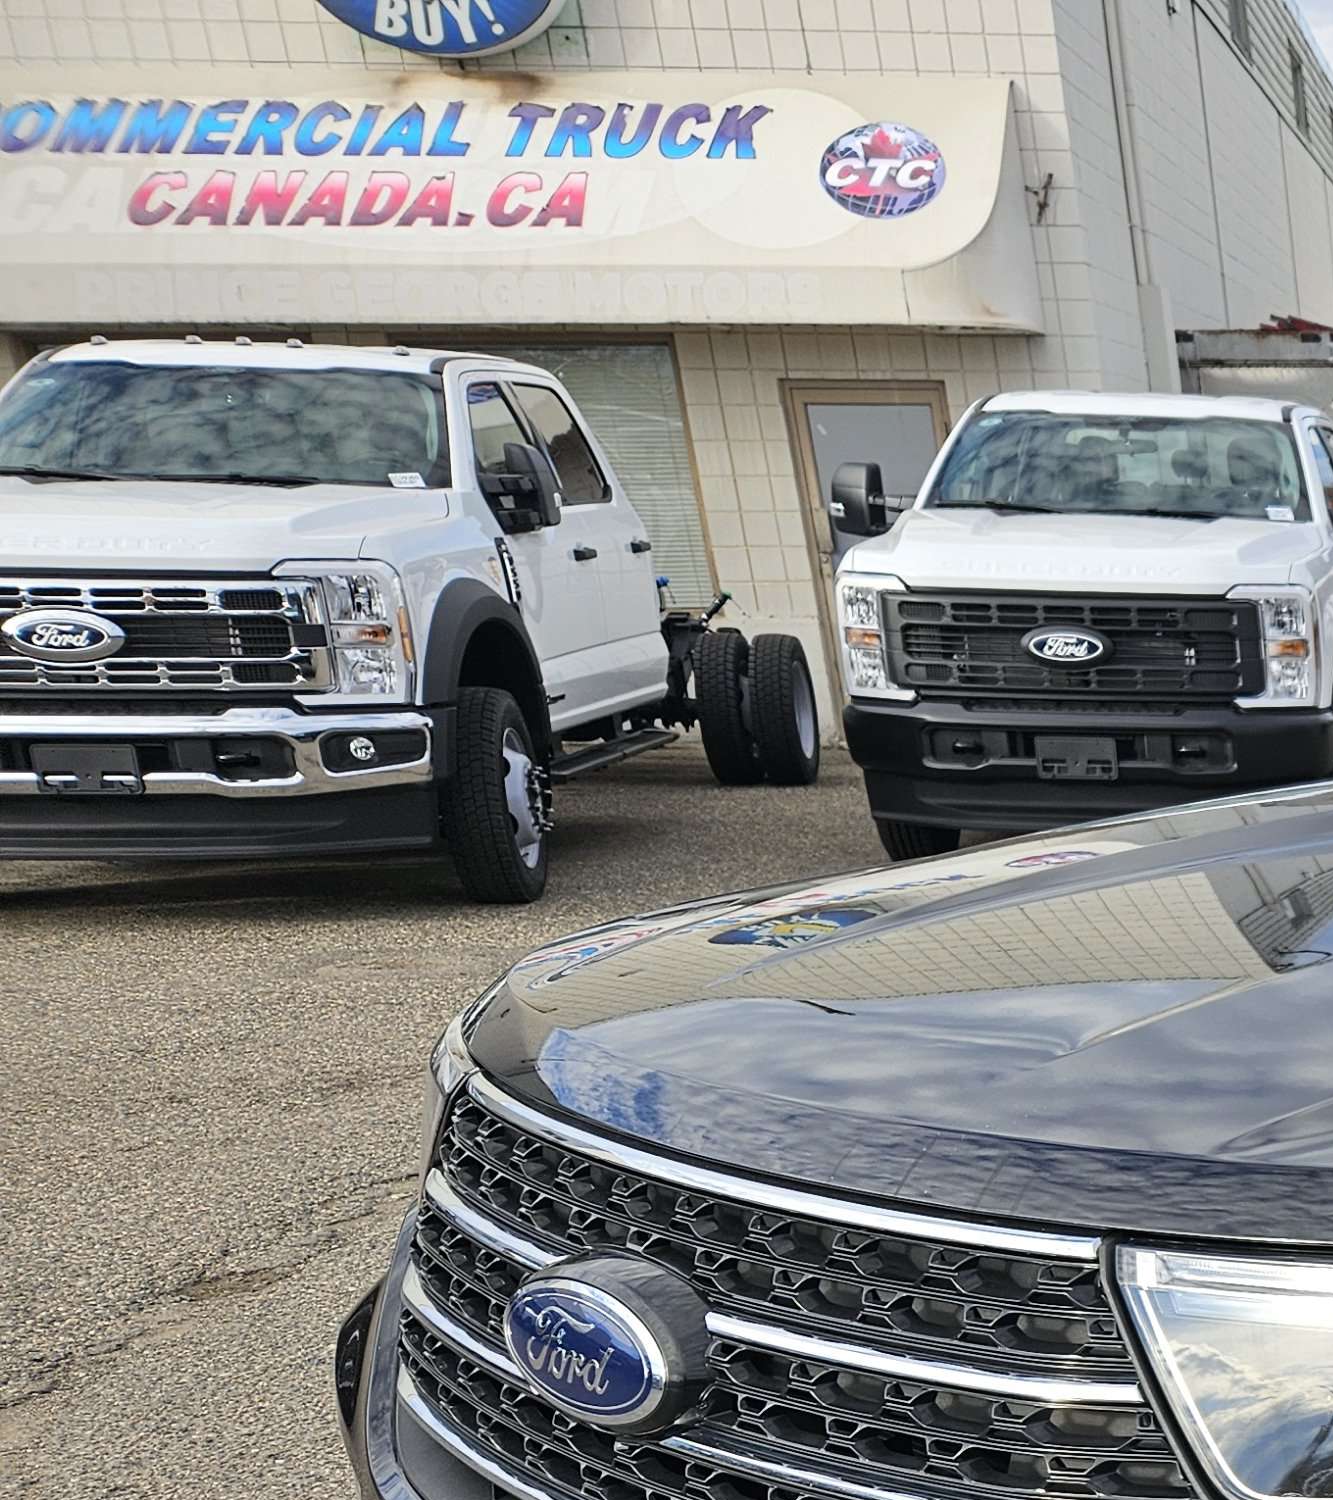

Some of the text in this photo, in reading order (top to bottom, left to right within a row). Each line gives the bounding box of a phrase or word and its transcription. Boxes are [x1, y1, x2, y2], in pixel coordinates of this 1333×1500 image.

[0, 97, 774, 160] OMMERCIAL TRUCK
[825, 157, 937, 189] CTC
[126, 169, 589, 228] CANADA.CA
[31, 623, 91, 648] Ford
[1042, 637, 1089, 657] Ford
[524, 1305, 616, 1396] Ford
